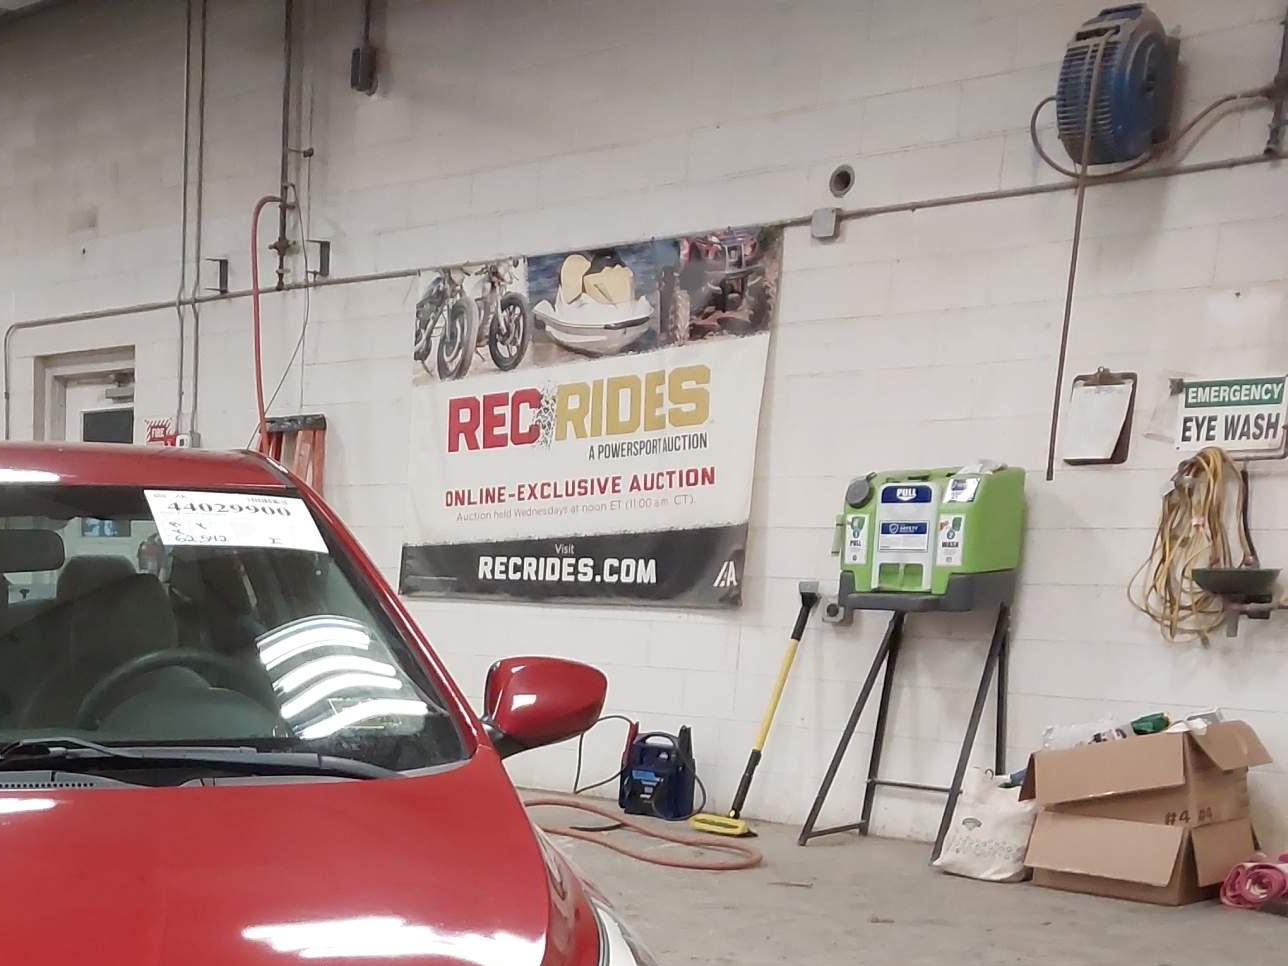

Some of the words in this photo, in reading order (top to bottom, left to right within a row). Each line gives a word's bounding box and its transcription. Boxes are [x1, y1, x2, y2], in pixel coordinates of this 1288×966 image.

[1187, 383, 1284, 404] EMERGENCY
[448, 388, 543, 452] REC
[555, 365, 711, 441] RIDES
[1181, 415, 1218, 442] EYE
[1223, 412, 1281, 441] WASH
[589, 445, 595, 460] A
[445, 476, 622, 507] ONLINE-EXCLUSIVE
[629, 467, 716, 493] AUCTION
[896, 488, 917, 497] PULL
[168, 501, 291, 517] 44029900
[457, 511, 492, 521] Auction
[494, 508, 512, 519] held
[514, 503, 568, 518] Wednesdays
[582, 502, 607, 513] noon
[555, 544, 575, 555] Visit
[478, 556, 657, 584] RECRIDES.COM
[1165, 810, 1191, 826] #4
